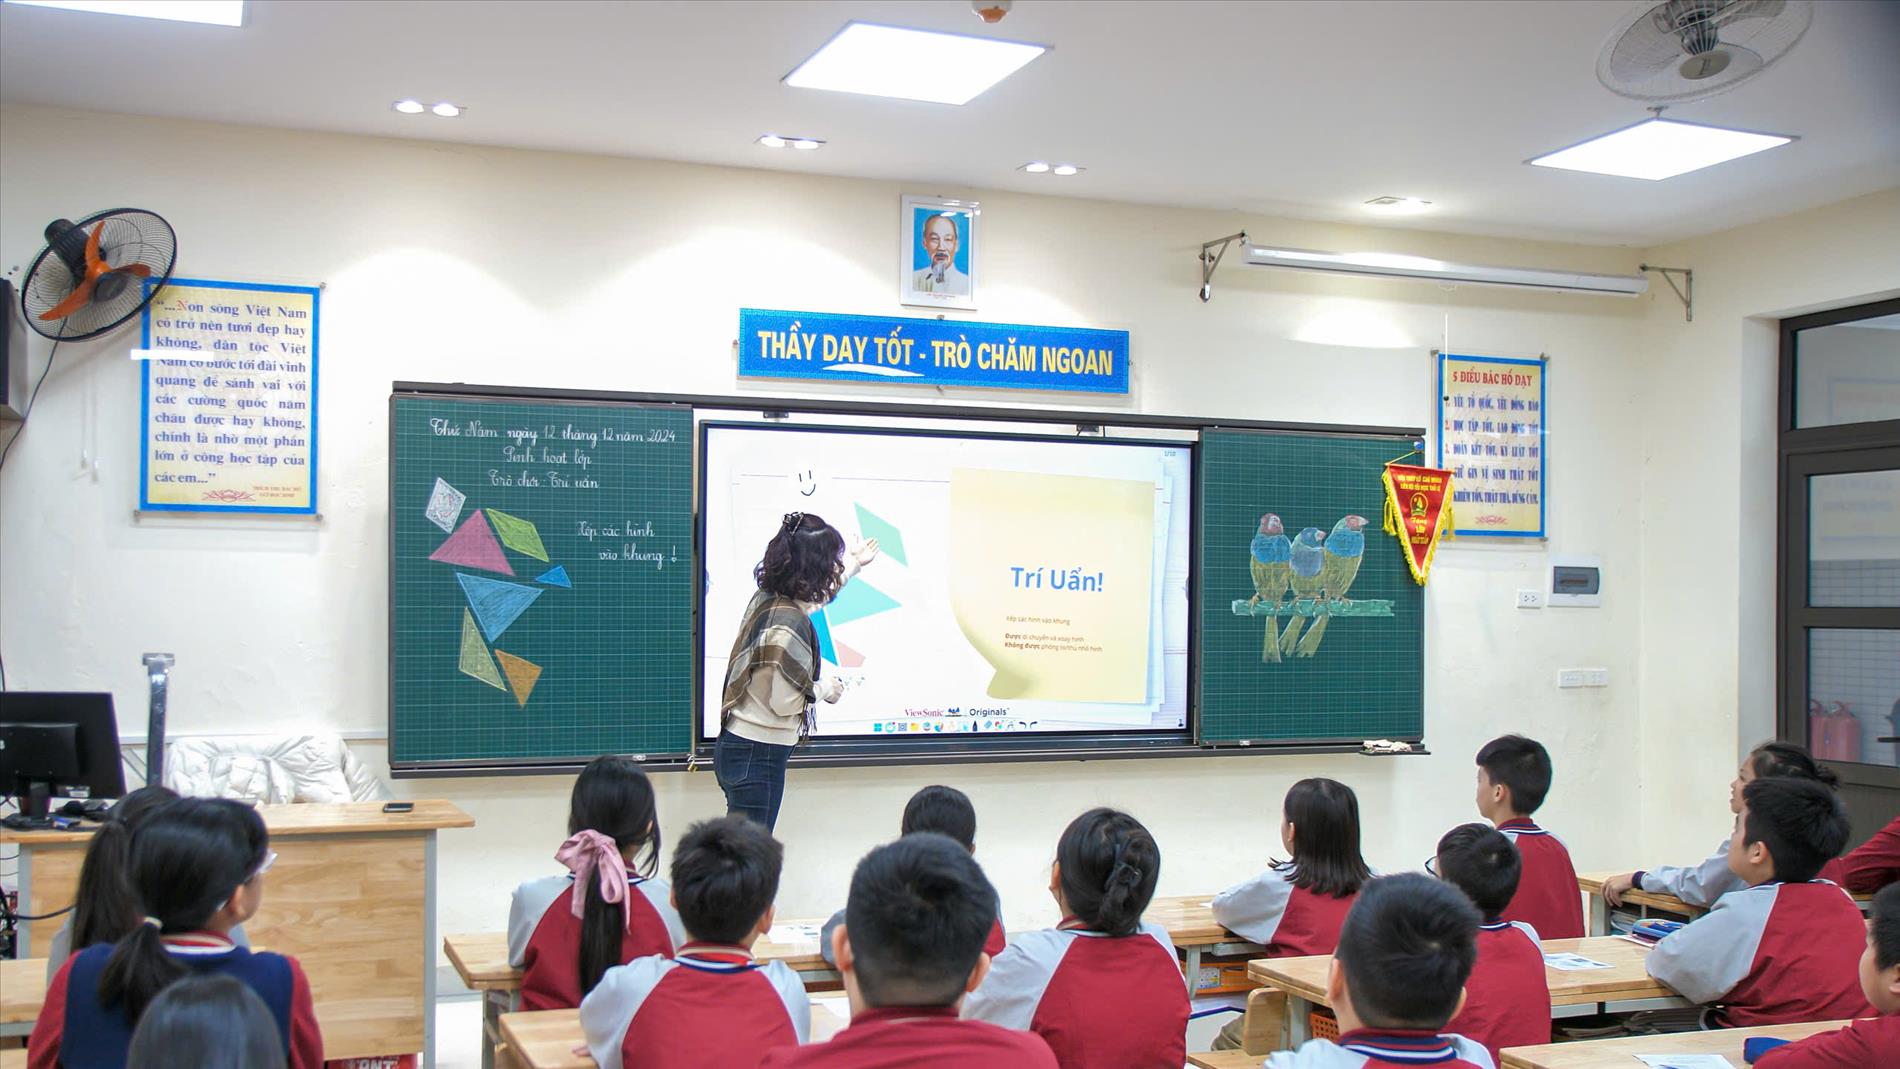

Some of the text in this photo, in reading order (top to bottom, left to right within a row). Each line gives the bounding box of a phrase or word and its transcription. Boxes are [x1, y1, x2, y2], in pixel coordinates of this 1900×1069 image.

[210, 303, 239, 317] sông
[246, 304, 272, 318] Việt
[278, 306, 307, 319] Nam
[156, 318, 172, 328] có
[200, 320, 222, 331] nên
[228, 321, 252, 333] tươi
[257, 321, 279, 337] đẹp
[285, 324, 306, 338] hay
[213, 339, 238, 351] dân
[250, 341, 269, 353] tộc
[280, 342, 307, 355] Việt
[757, 320, 816, 361] THẦY
[874, 326, 914, 365] TỐT
[932, 335, 972, 368] TRÒ
[977, 339, 1037, 372] CHĂM
[1042, 346, 1114, 377] NGOAN
[239, 360, 255, 370] tới
[257, 360, 277, 372] đài
[280, 361, 306, 373] vinh
[156, 376, 196, 389] quang
[225, 377, 255, 389] sánh
[262, 379, 281, 390] vai
[288, 378, 306, 391] với
[1453, 366, 1533, 389] 5 ĐIỀU BÁC HỒ DẠY
[155, 394, 306, 410] các cường quốc năm
[155, 412, 186, 424] châu
[194, 413, 225, 427] được
[233, 415, 256, 429] hay
[155, 431, 305, 449] chính là nhờ một phần
[507, 427, 538, 447] ngày
[543, 425, 557, 440] 12
[562, 424, 598, 449] tháng
[602, 427, 615, 441] 12
[616, 432, 644, 442] năm
[647, 429, 676, 443] 2024
[155, 450, 305, 467] lớn ở công học tập của
[503, 446, 593, 470] Sinh hoạt lớp
[155, 472, 178, 483] các
[488, 469, 513, 487] Trò
[517, 470, 540, 487] chơi
[577, 520, 655, 541] Xếp các hình
[600, 549, 618, 560] vào
[624, 542, 665, 570] khung
[1010, 567, 1104, 592] Trí Uẩn!
[905, 708, 944, 717] ViewSonic
